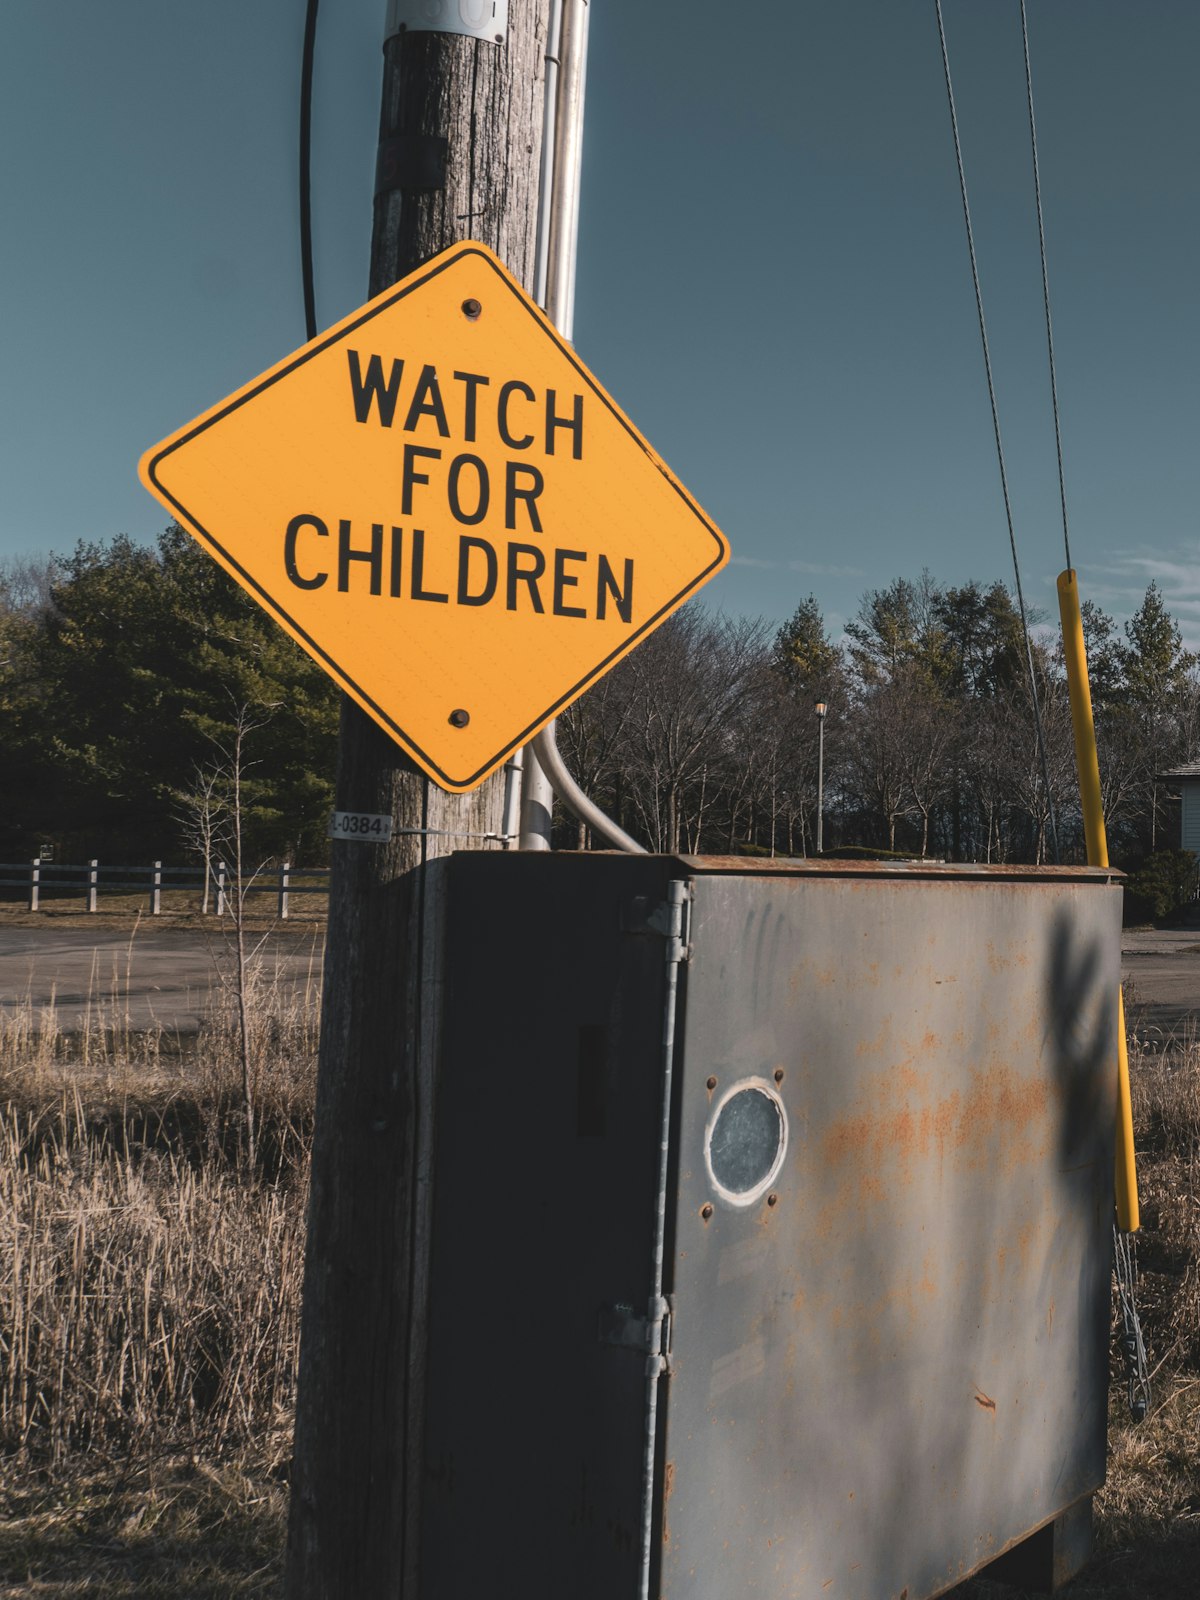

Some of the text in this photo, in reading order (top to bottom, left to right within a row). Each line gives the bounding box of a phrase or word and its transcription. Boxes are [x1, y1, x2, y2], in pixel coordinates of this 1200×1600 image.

[347, 349, 584, 460] WATCH
[401, 443, 544, 533] FOR
[284, 513, 634, 624] CHILDREN
